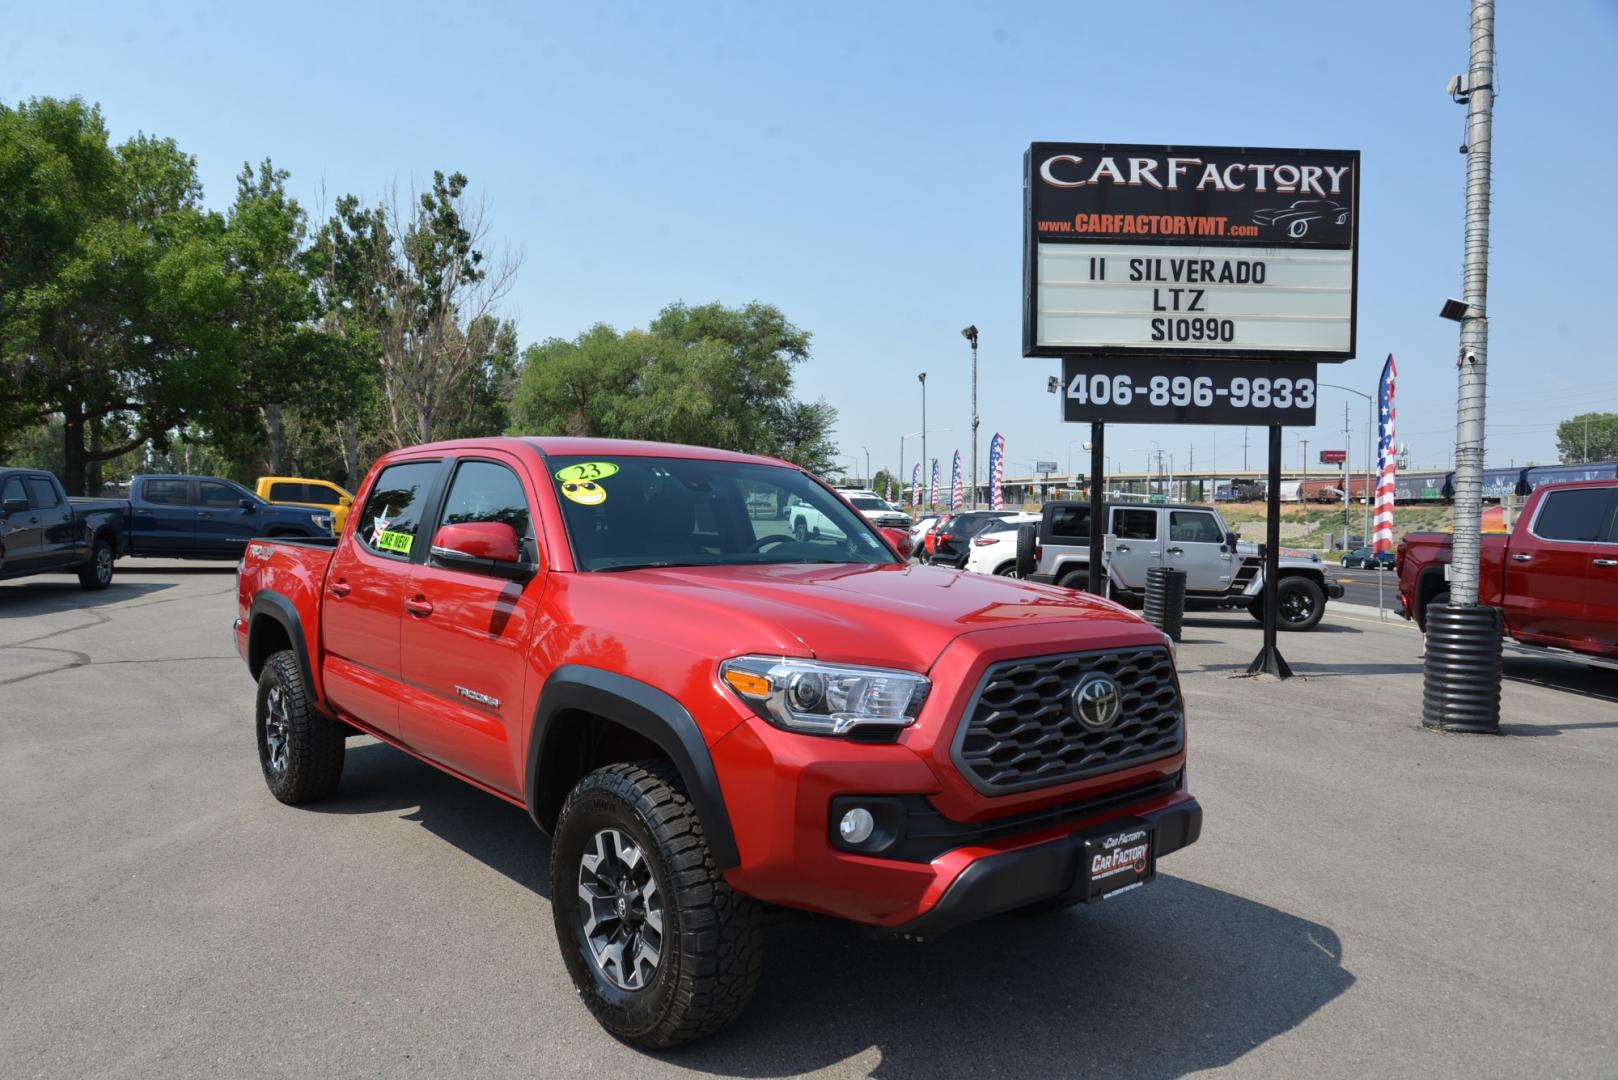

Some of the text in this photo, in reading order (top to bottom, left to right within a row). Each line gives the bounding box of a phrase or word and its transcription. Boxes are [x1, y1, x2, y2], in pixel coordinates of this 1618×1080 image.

[1038, 213, 1259, 237] www.CARFACTORYMT.com
[1129, 258, 1266, 284] SILVERADO
[1153, 288, 1205, 312] LTZ
[1067, 374, 1315, 409] 406-896-9833
[573, 463, 601, 479] 23
[393, 534, 410, 549] NEW
[1091, 854, 1112, 873] CAR
[1112, 843, 1148, 867] FACTORY
